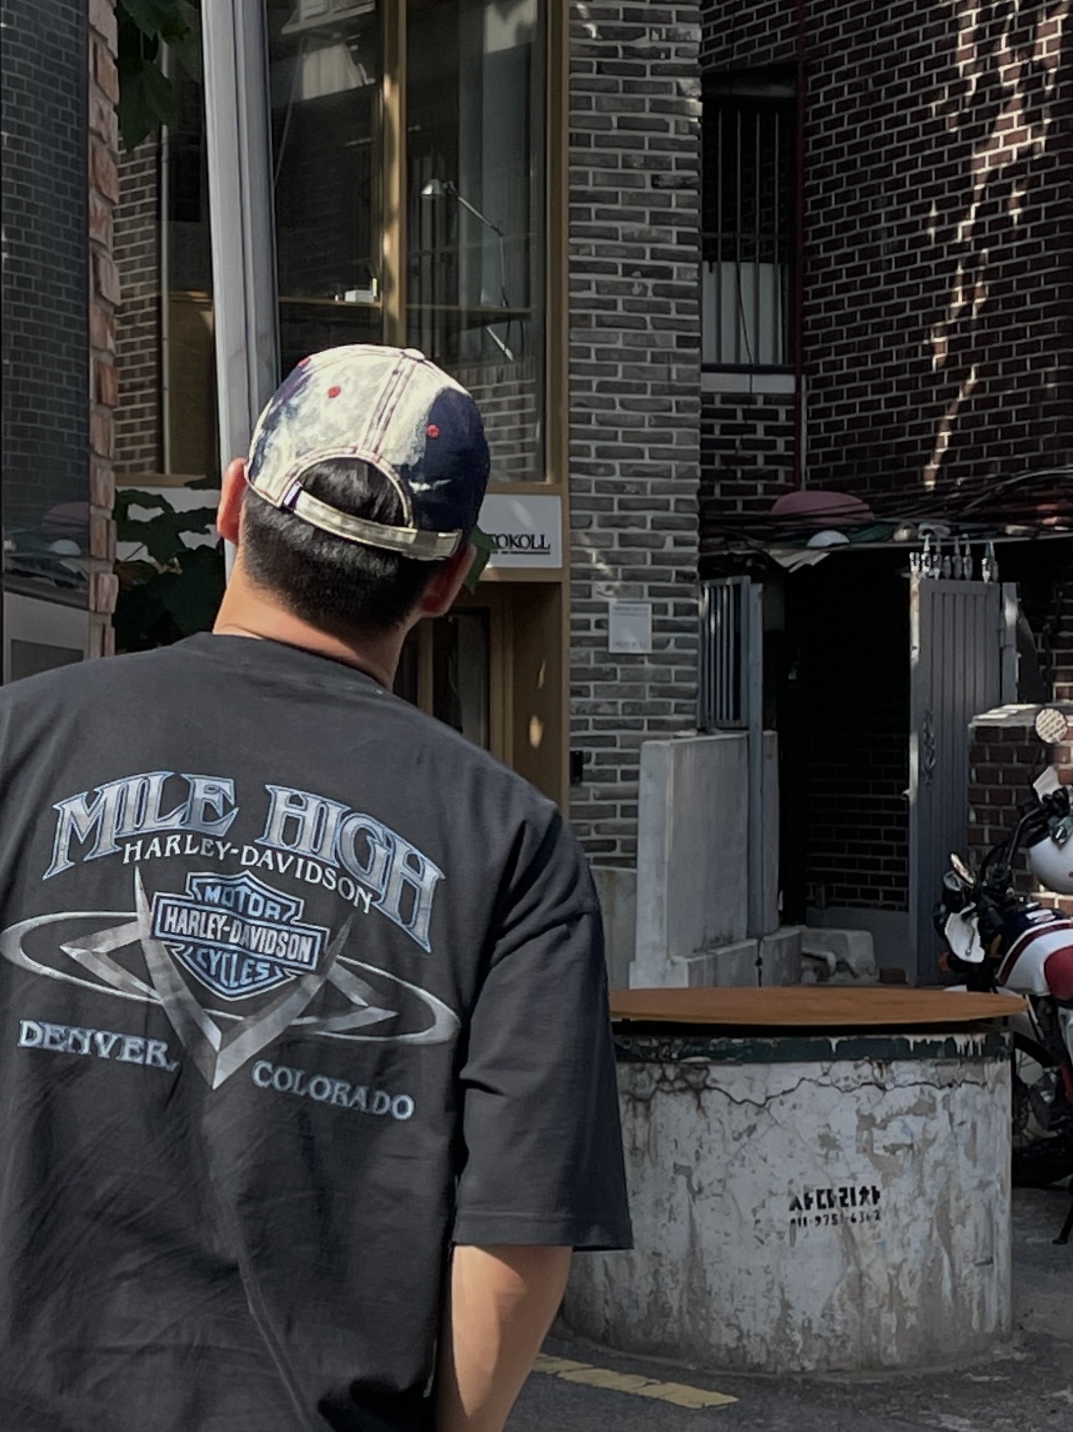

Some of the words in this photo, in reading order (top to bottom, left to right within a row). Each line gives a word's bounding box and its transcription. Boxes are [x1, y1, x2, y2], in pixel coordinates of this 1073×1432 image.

[487, 534, 551, 550] OKOLL
[42, 770, 239, 880] MILE
[254, 784, 446, 953] HIGH
[122, 833, 373, 914] HARLEY-DAVIDSON
[204, 884, 282, 921] MOTOR
[164, 905, 314, 963] HARLEY-DAVIDSON
[196, 947, 271, 988] CYCLES
[252, 1060, 415, 1121] COLORADO
[789, 1185, 881, 1211] 사다리차
